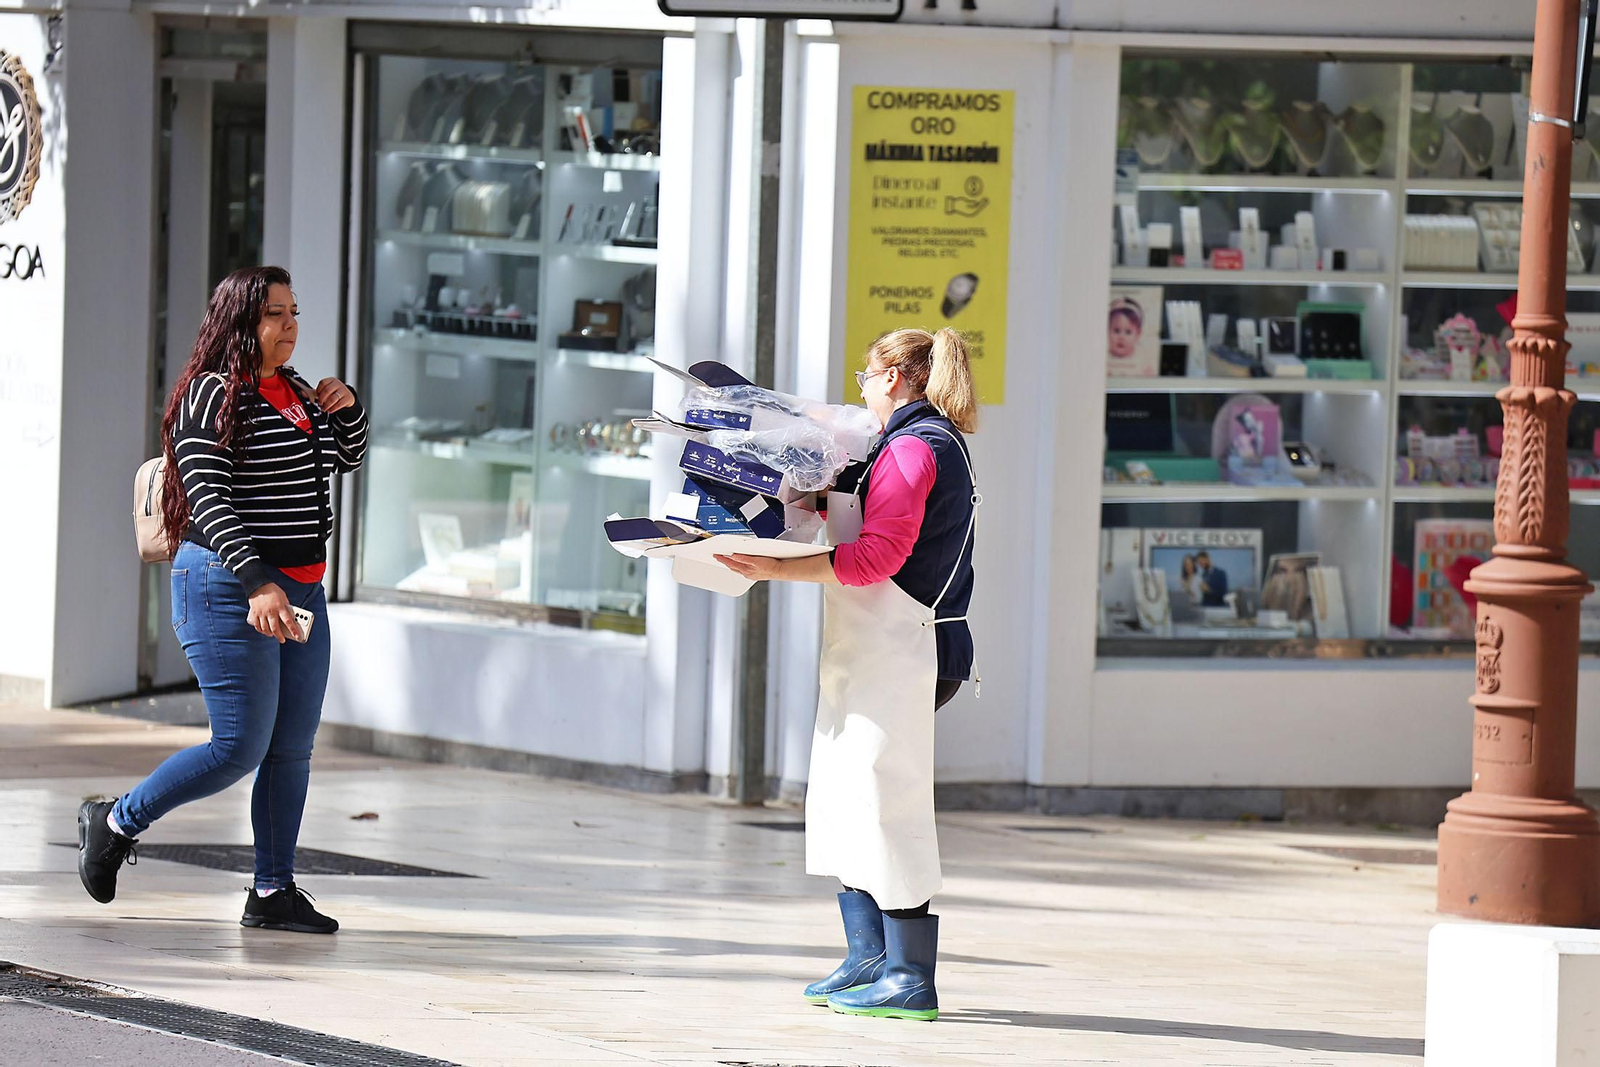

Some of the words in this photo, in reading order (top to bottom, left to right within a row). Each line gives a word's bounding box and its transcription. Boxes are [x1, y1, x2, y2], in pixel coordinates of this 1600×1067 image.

[867, 91, 1000, 112] COMPRAMOS
[911, 117, 956, 135] ORO
[865, 139, 924, 161] MÁXIMA
[929, 141, 999, 163] TASACIÓN
[869, 286, 934, 299] PONEMOS
[884, 301, 921, 315] PILAS
[1152, 531, 1253, 546] VICEROY
